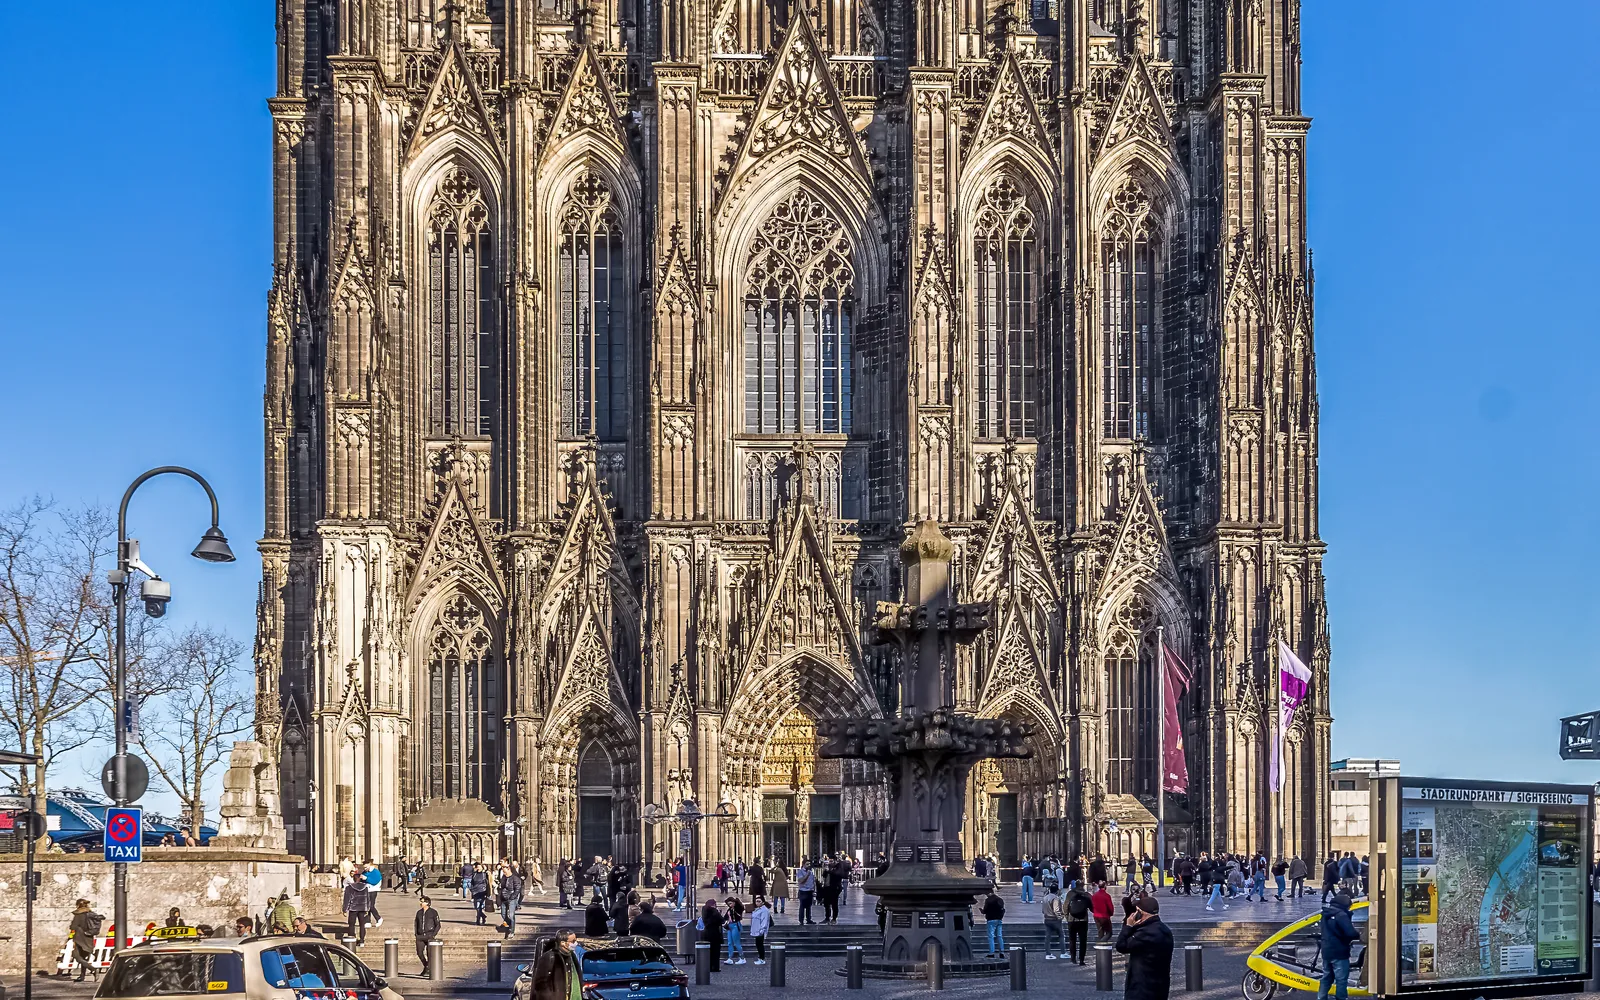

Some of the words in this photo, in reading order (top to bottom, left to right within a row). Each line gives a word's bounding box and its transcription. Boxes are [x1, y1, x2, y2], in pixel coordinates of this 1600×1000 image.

[1420, 788, 1506, 802] STADTRUNDFAHRT
[1516, 792, 1573, 804] SIGHTSEEING
[107, 845, 138, 858] TAXI
[164, 928, 186, 936] TAXI
